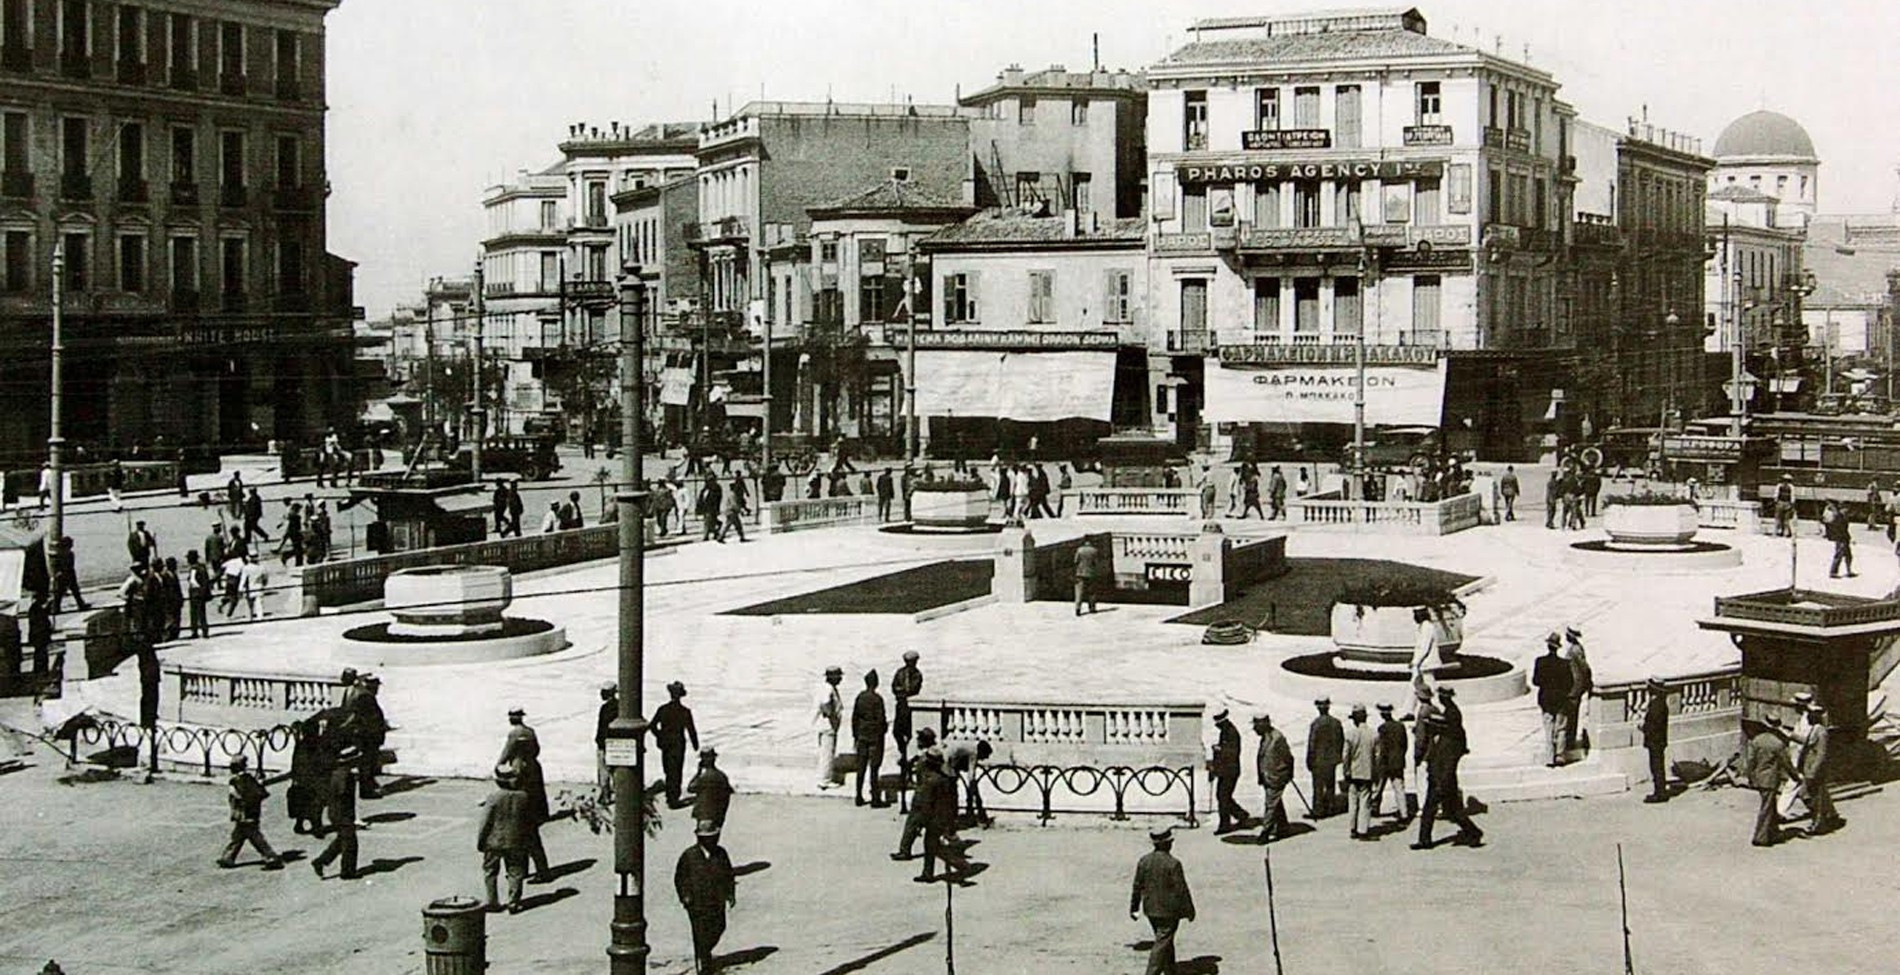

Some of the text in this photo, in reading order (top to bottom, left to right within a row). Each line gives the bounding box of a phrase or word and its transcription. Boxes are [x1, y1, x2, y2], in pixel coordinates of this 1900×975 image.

[1188, 167, 1278, 181] PHAROS
[1290, 162, 1382, 178] AGENCY
[184, 329, 226, 344] WHITE
[1252, 375, 1396, 387] ΦΑΡΜΑΚΕΟΝ
